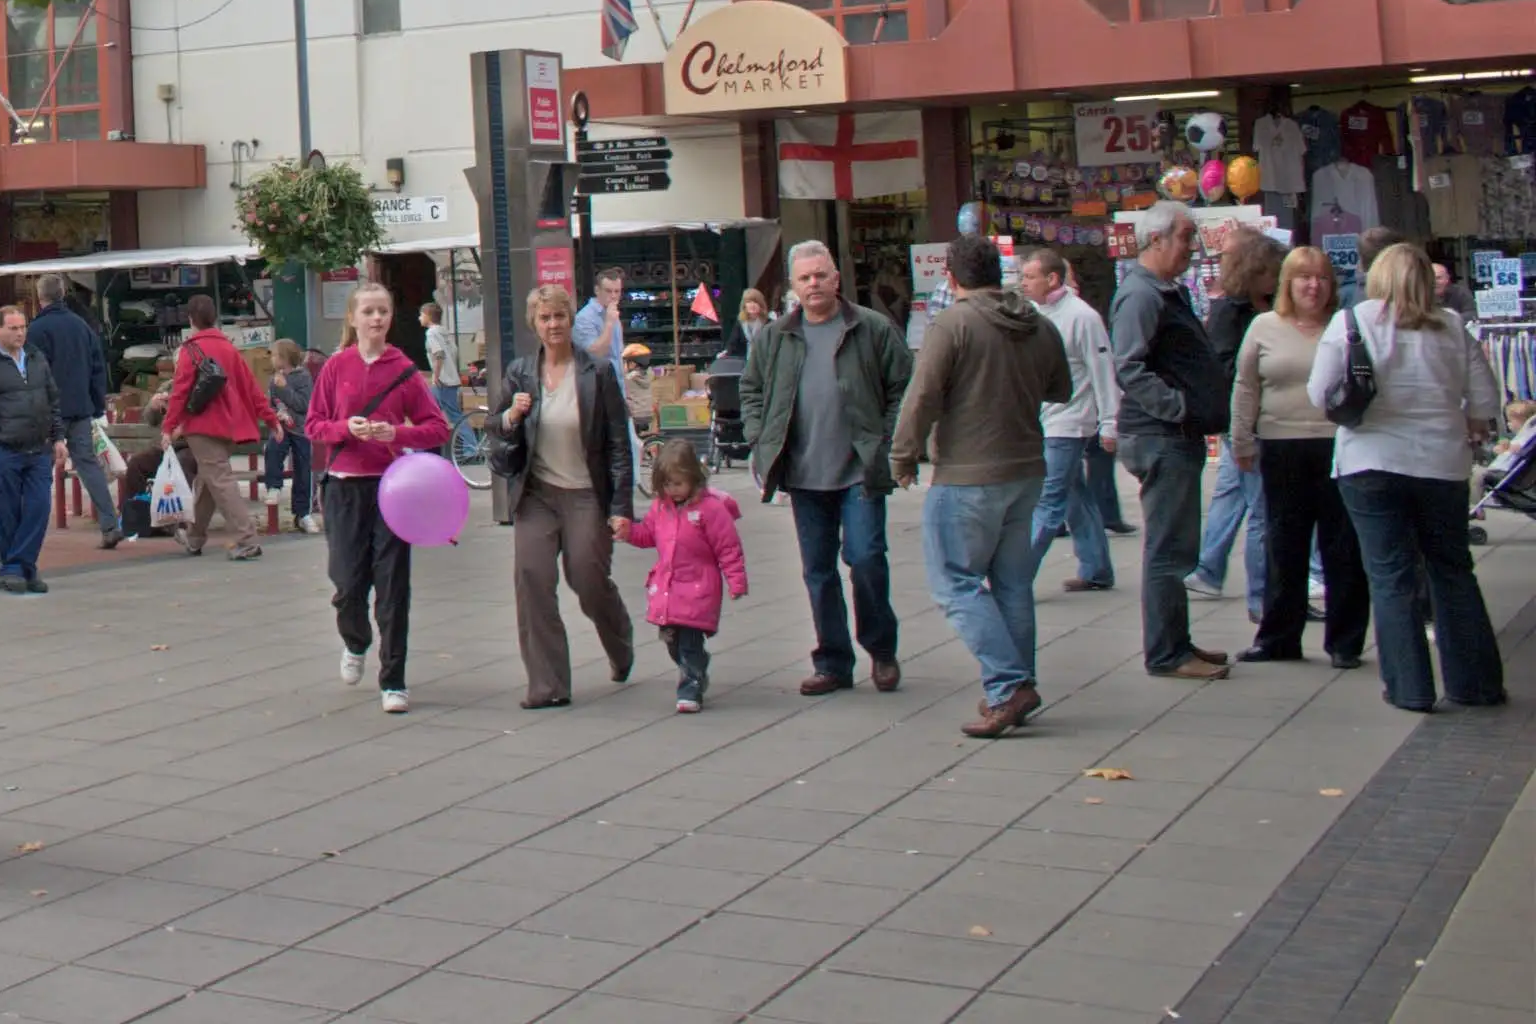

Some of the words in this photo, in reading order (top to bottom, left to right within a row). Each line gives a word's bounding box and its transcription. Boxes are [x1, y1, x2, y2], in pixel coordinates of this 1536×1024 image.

[681, 40, 824, 95] Chelmsford
[724, 73, 824, 95] MARKET
[430, 205, 440, 219] C
